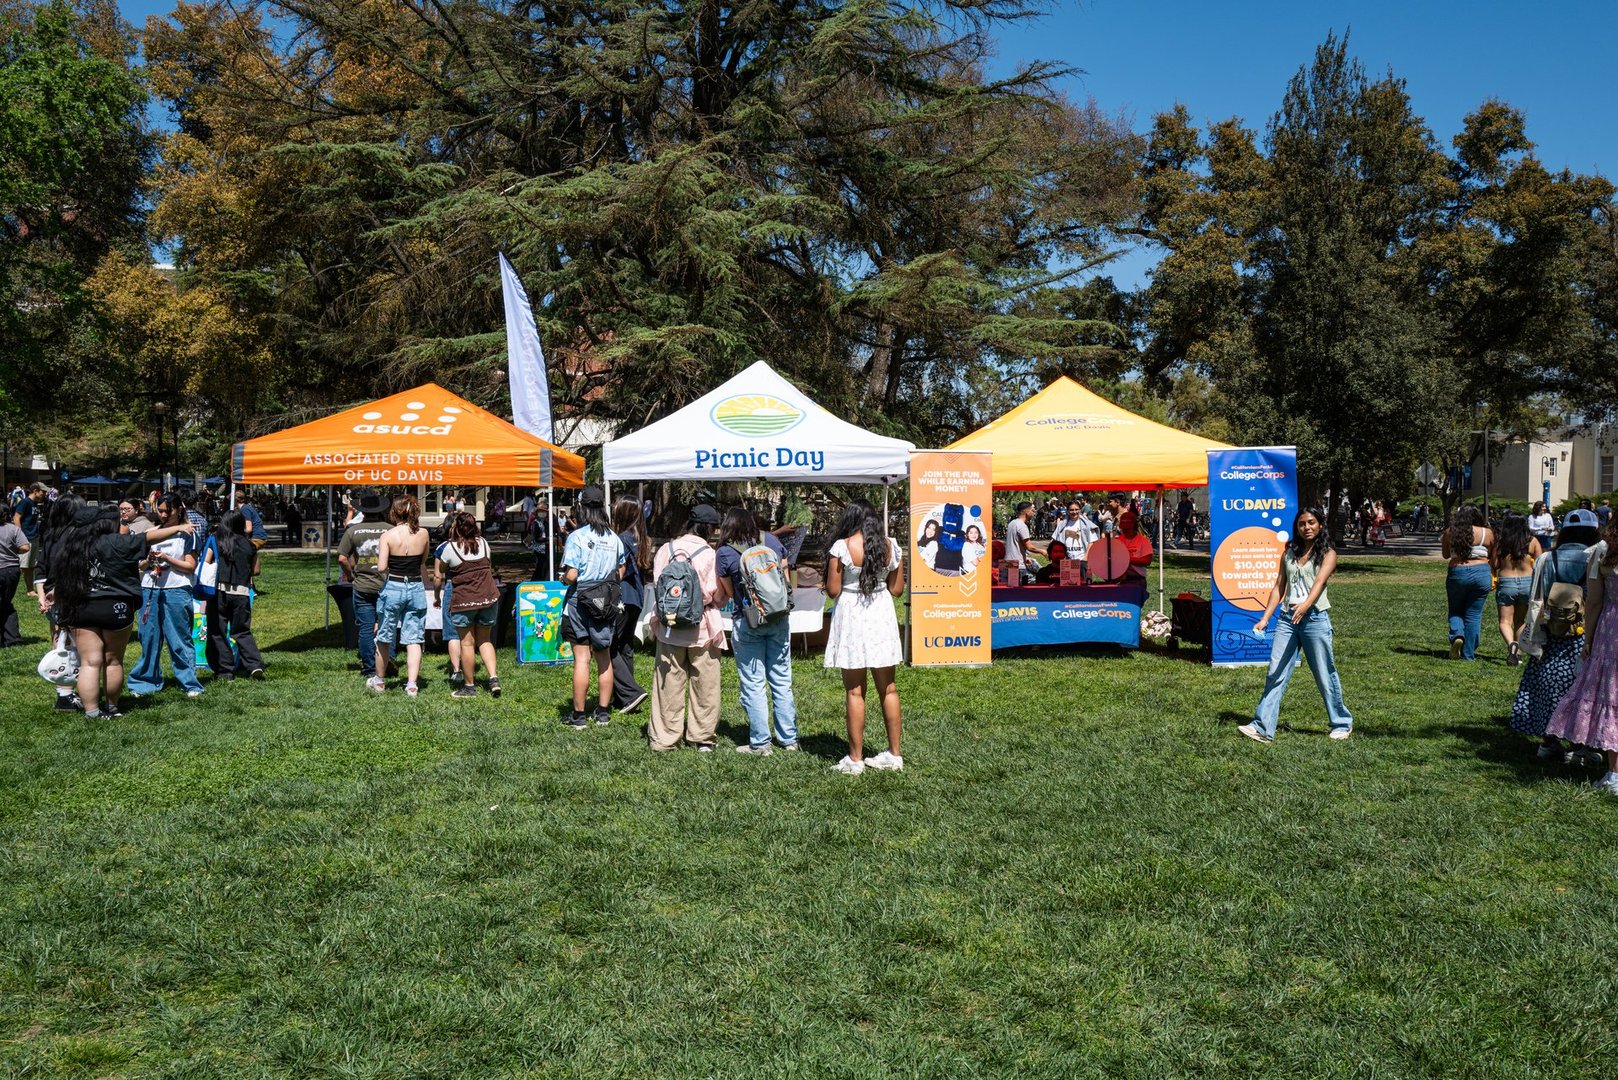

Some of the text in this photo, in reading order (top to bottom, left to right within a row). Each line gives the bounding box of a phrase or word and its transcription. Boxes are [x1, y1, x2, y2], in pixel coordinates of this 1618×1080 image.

[352, 423, 453, 436] asucd
[303, 453, 484, 465] ASSOCIATED STUDENTS
[695, 447, 825, 471] Picnic Day
[344, 469, 443, 481] OF UC DAVIS
[1220, 471, 1285, 480] CollegeCorps
[1234, 561, 1276, 570] $10,000
[1222, 571, 1279, 581] towards yo
[1237, 580, 1274, 589] tuition!
[923, 609, 982, 619] CollegeCorps
[1052, 608, 1132, 619] CollegeCorps
